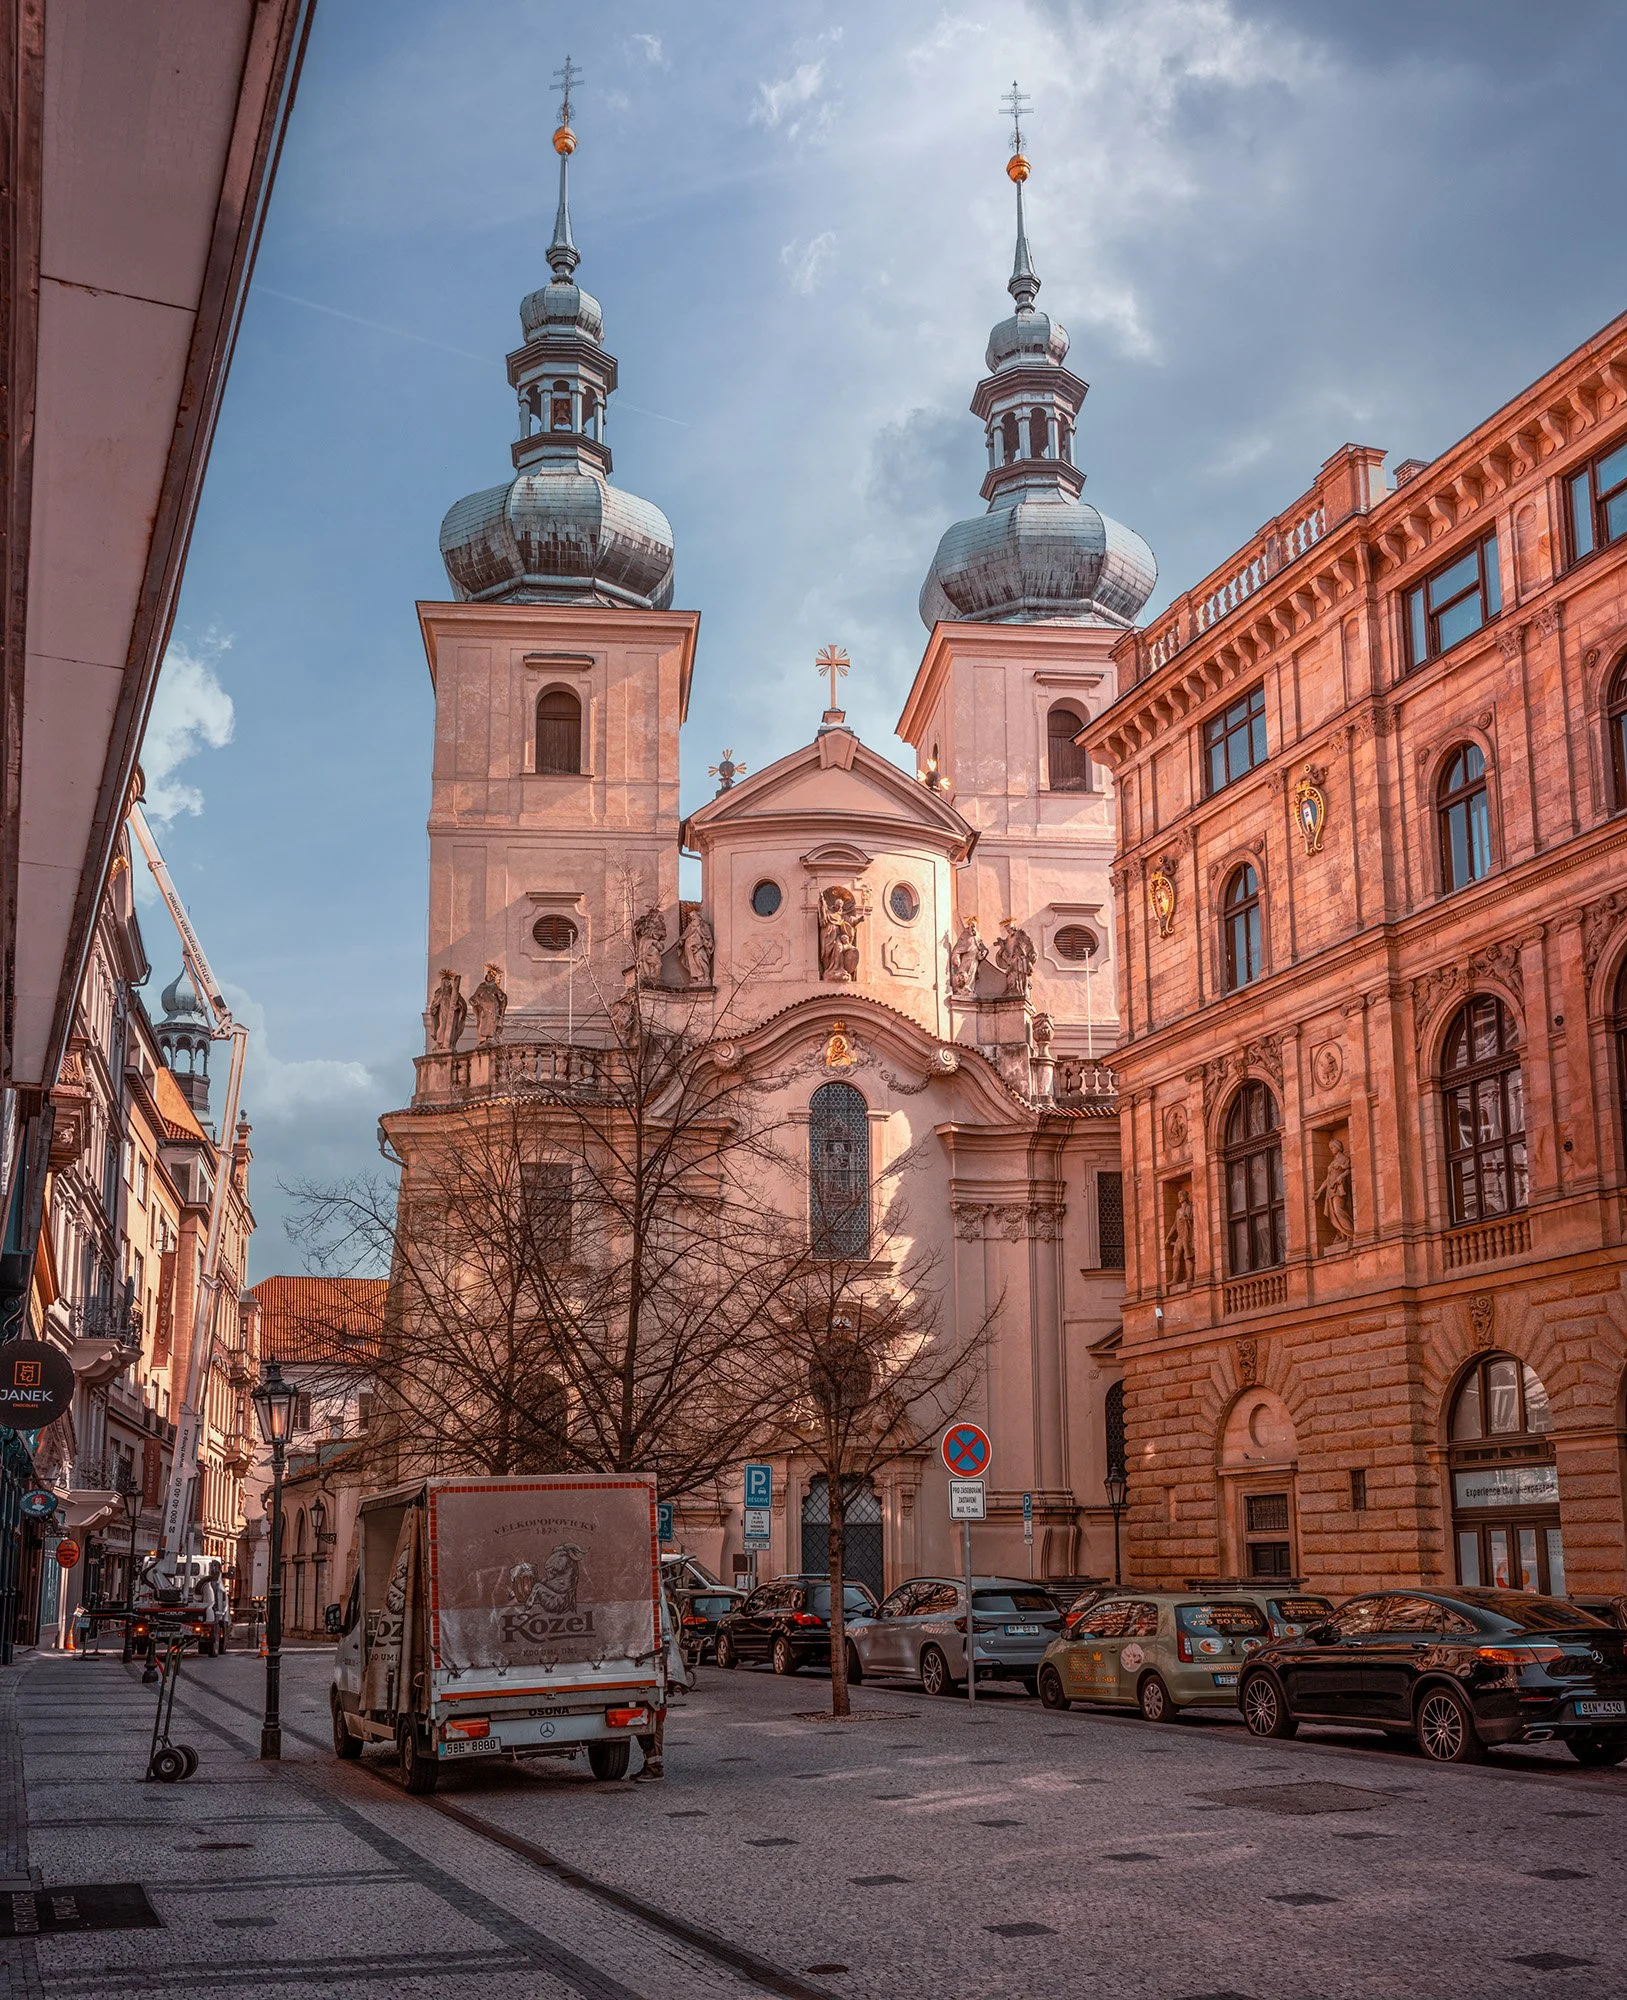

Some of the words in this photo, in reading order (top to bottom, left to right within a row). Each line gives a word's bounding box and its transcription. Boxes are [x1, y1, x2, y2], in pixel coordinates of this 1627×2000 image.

[167, 892, 184, 919] PORUCHY
[180, 919, 198, 953] VEŘEJNÉHO
[194, 953, 213, 984] OSVĚTLENÍ
[0, 1389, 53, 1401] JANEK
[180, 1429, 189, 1468] www.thmp.cz
[175, 1477, 182, 1487] 60
[751, 1470, 766, 1495] P
[173, 1488, 181, 1498] 40
[1466, 1487, 1500, 1498] Experience
[1502, 1486, 1513, 1495] the
[172, 1499, 179, 1510] 40
[1025, 1496, 1029, 1510] P
[169, 1510, 178, 1524] 800
[536, 1527, 558, 1535] 1874
[501, 1611, 597, 1644] Kozel
[523, 1649, 539, 1657] KDO
[528, 1707, 570, 1716] OSONA
